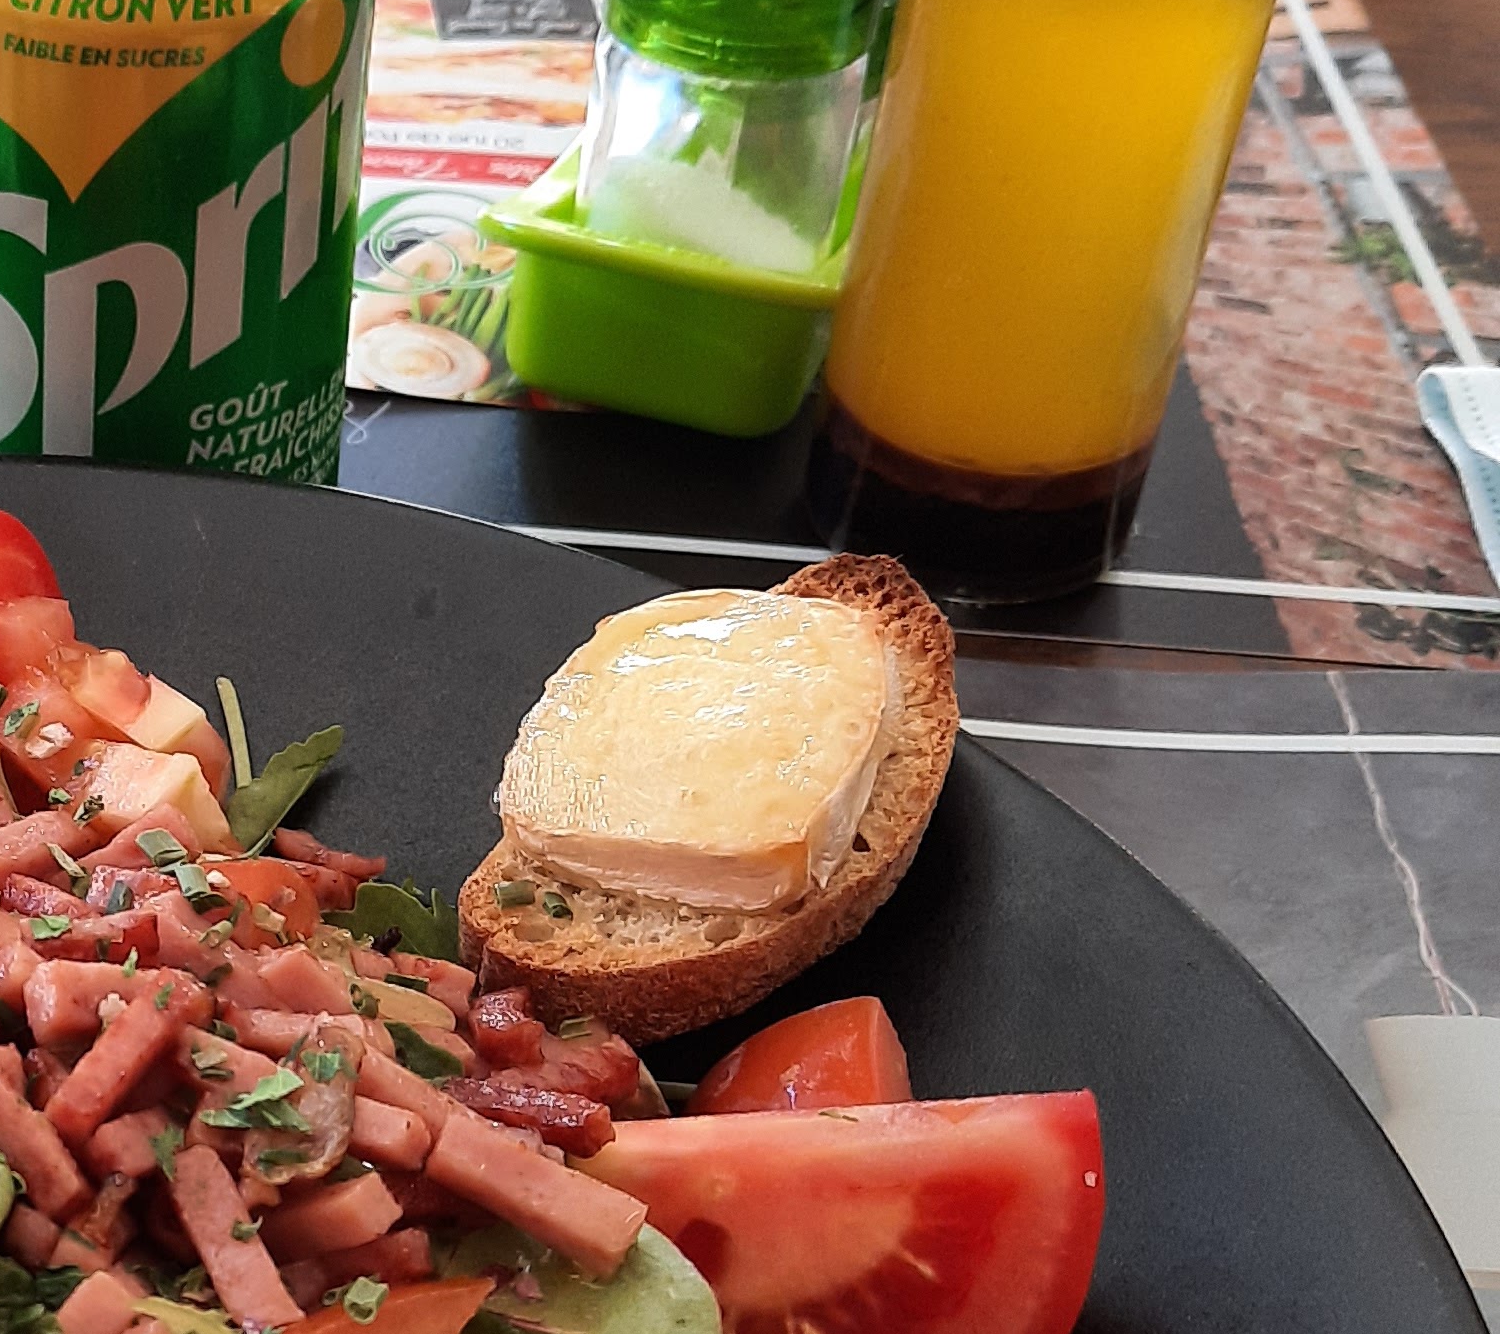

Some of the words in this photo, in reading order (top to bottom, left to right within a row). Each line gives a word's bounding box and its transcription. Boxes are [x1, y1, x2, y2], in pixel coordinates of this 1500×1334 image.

[3, 32, 75, 64] FAIBLE
[78, 46, 110, 67] EN
[115, 45, 206, 69] SUCRES
[188, 380, 289, 431] GOÛT
